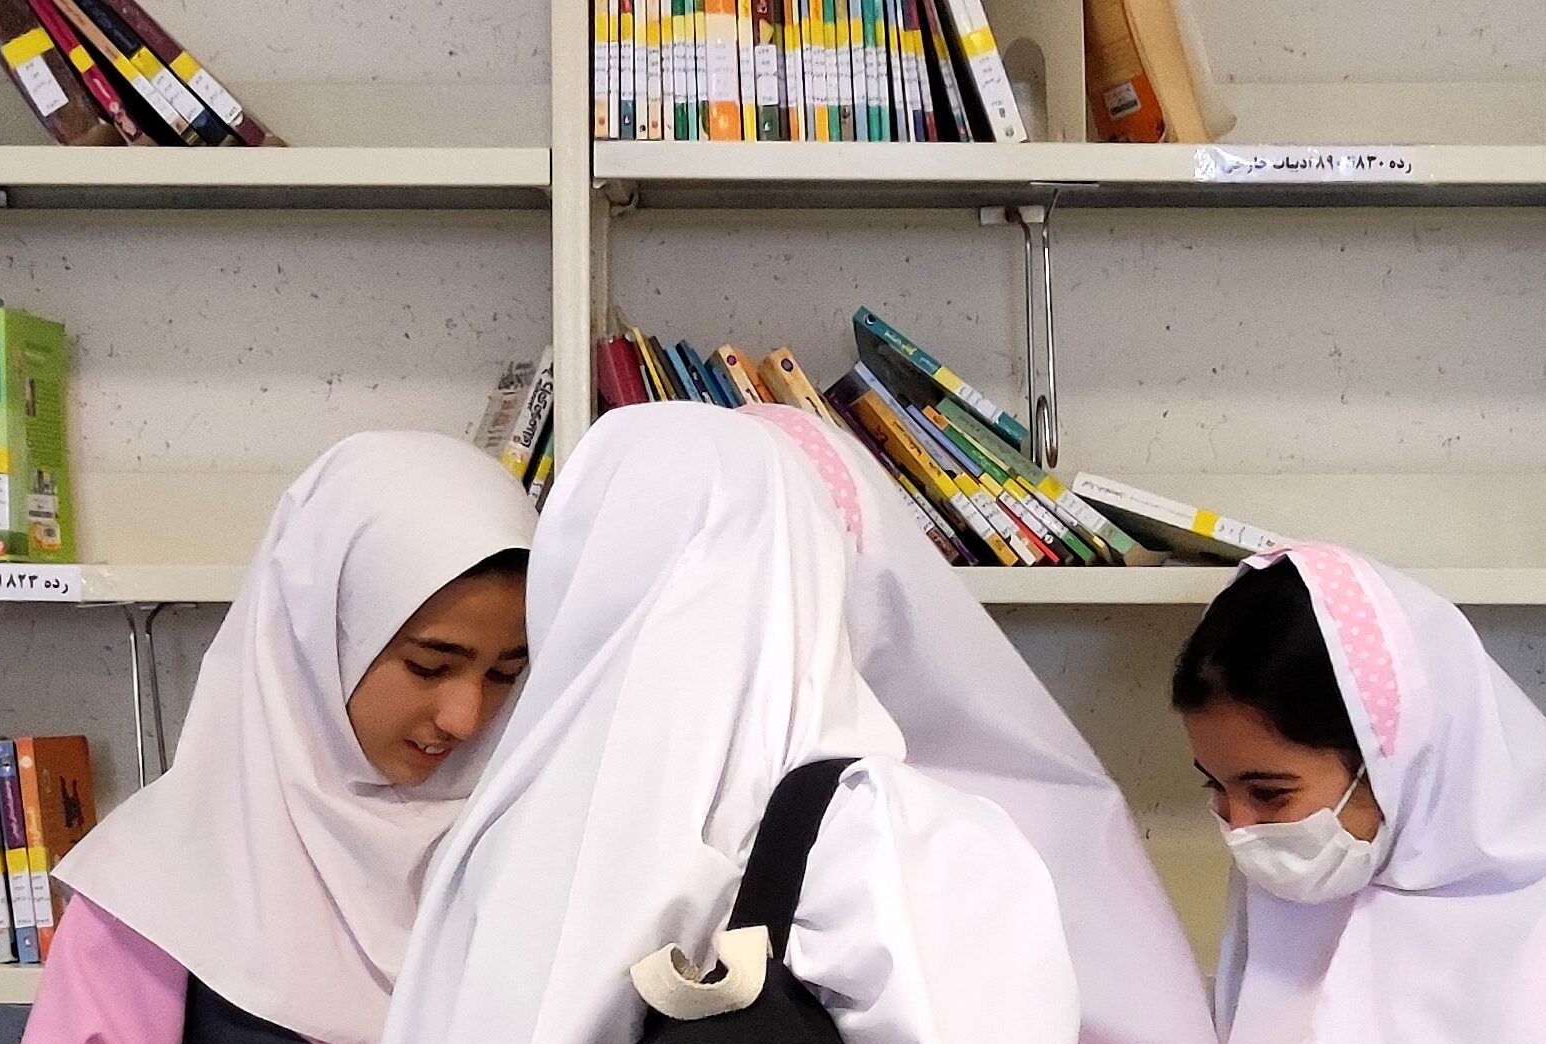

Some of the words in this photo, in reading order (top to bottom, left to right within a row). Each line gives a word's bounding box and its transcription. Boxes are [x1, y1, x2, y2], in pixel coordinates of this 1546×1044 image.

[1272, 156, 1312, 173] ادبیات
[1389, 157, 1412, 174] رده
[6, 573, 38, 589] ۸۲۳
[44, 578, 69, 594] رده
